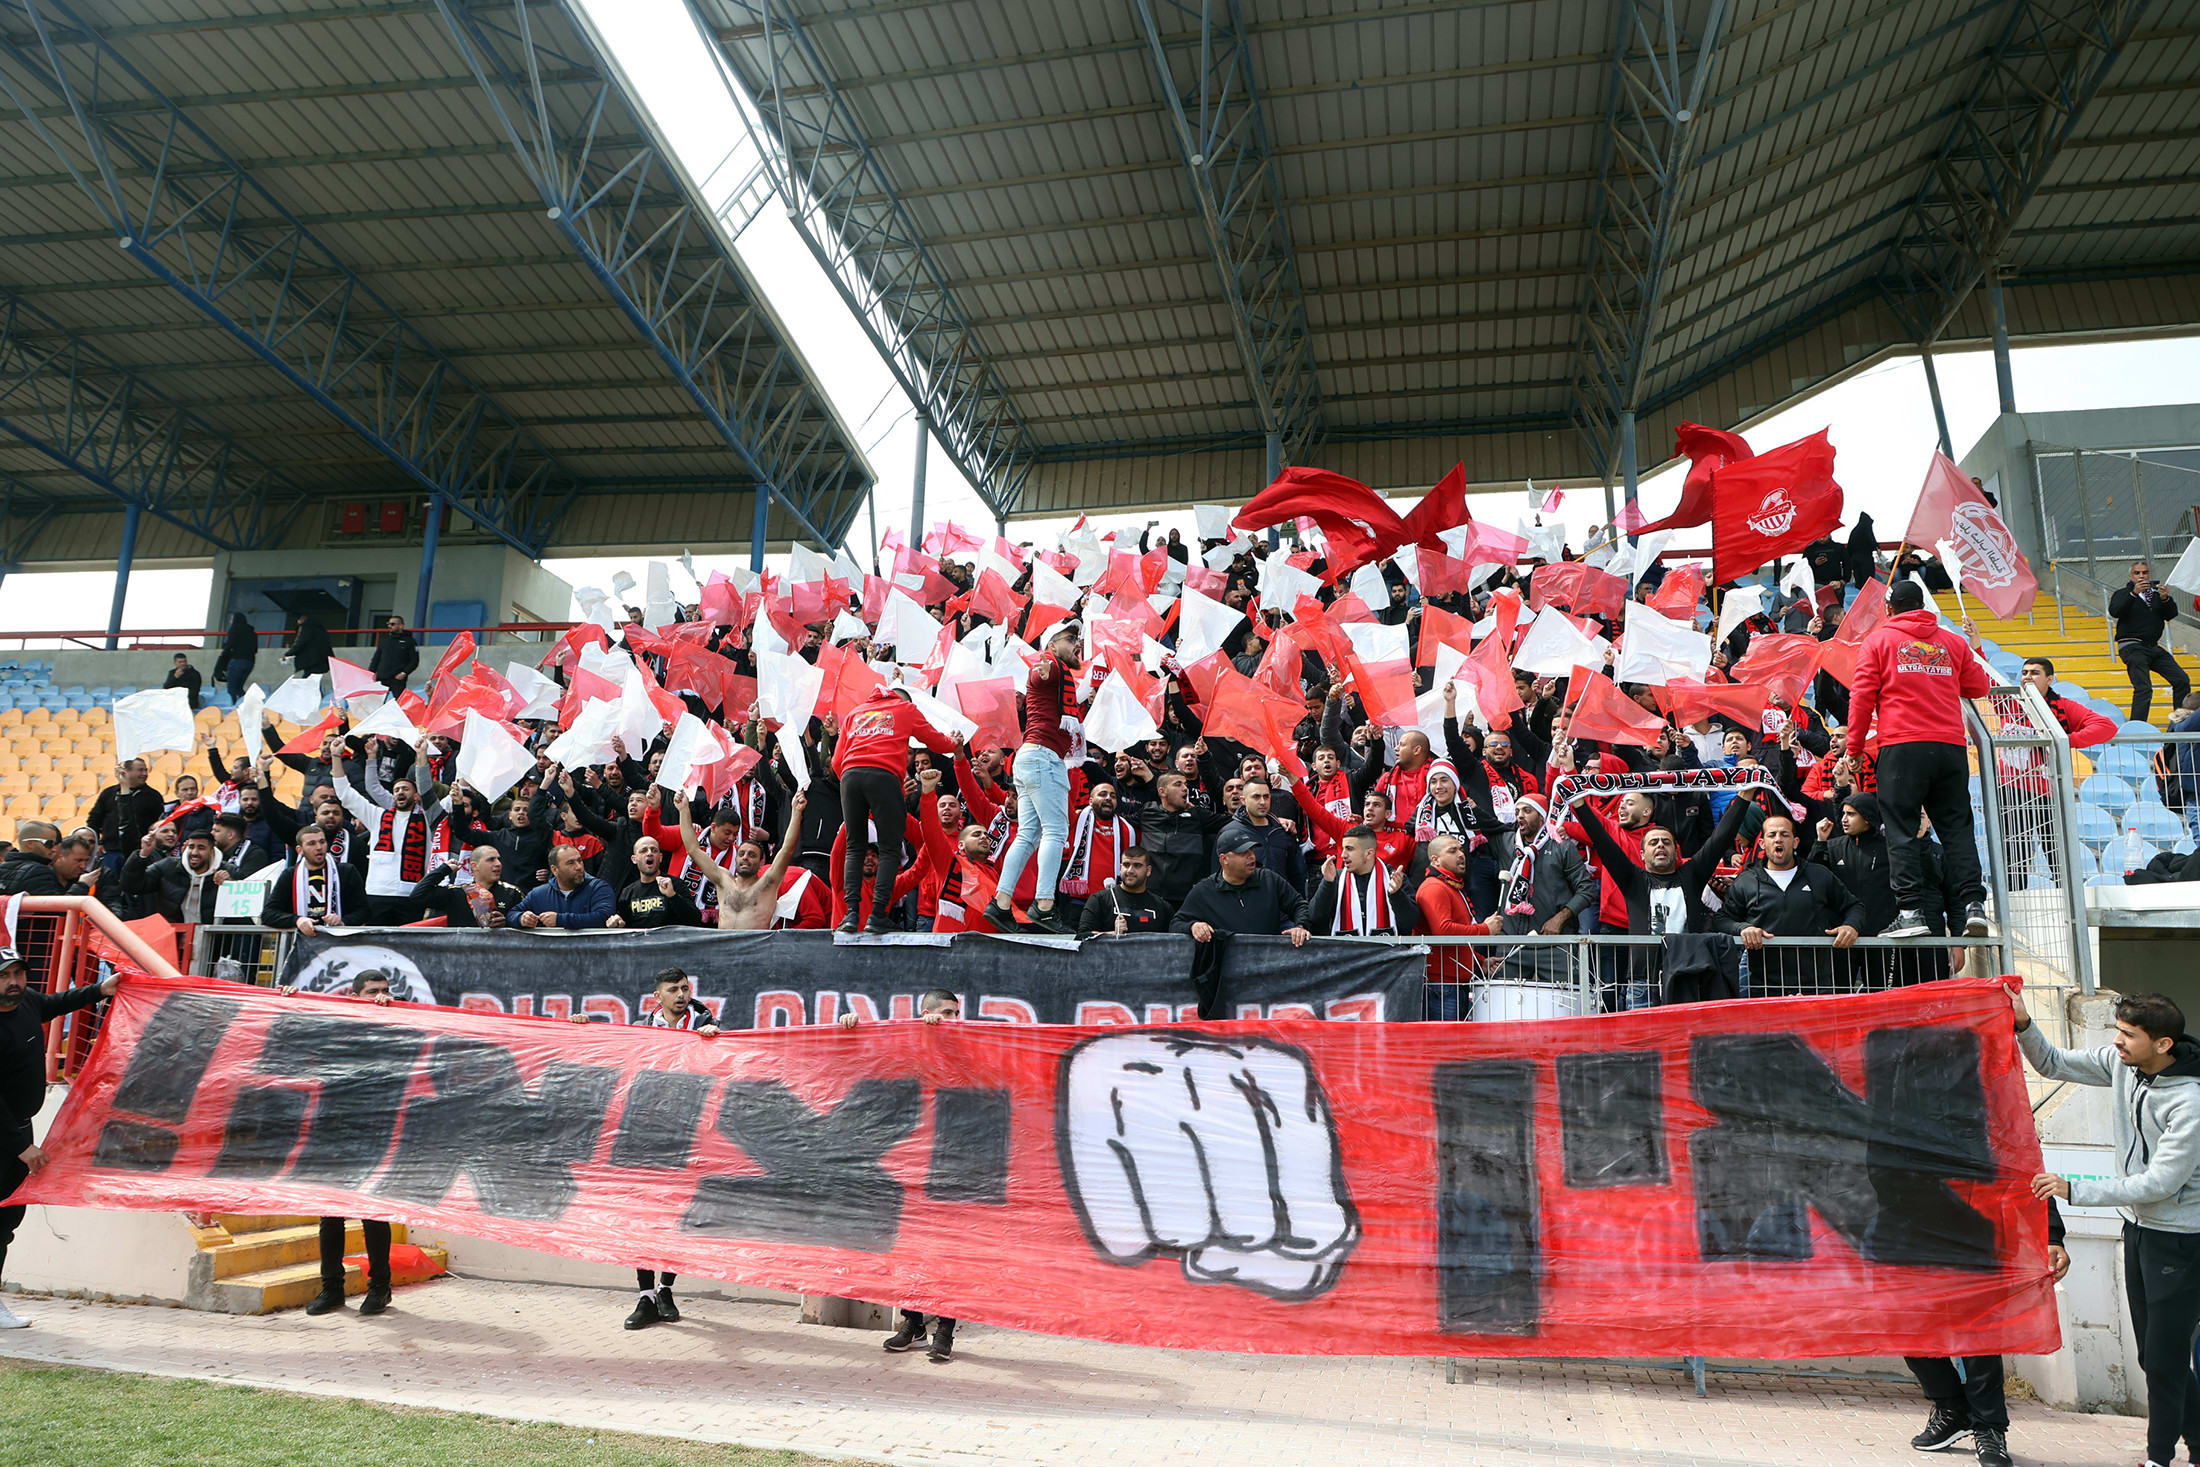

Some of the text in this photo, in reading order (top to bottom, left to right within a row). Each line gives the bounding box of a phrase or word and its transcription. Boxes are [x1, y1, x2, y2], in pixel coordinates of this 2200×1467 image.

[402, 820, 425, 882] TAYIBE
[222, 882, 263, 895] שער
[231, 900, 251, 916] 15
[631, 898, 664, 914] PIERRE
[1430, 1024, 2003, 1337] אין
